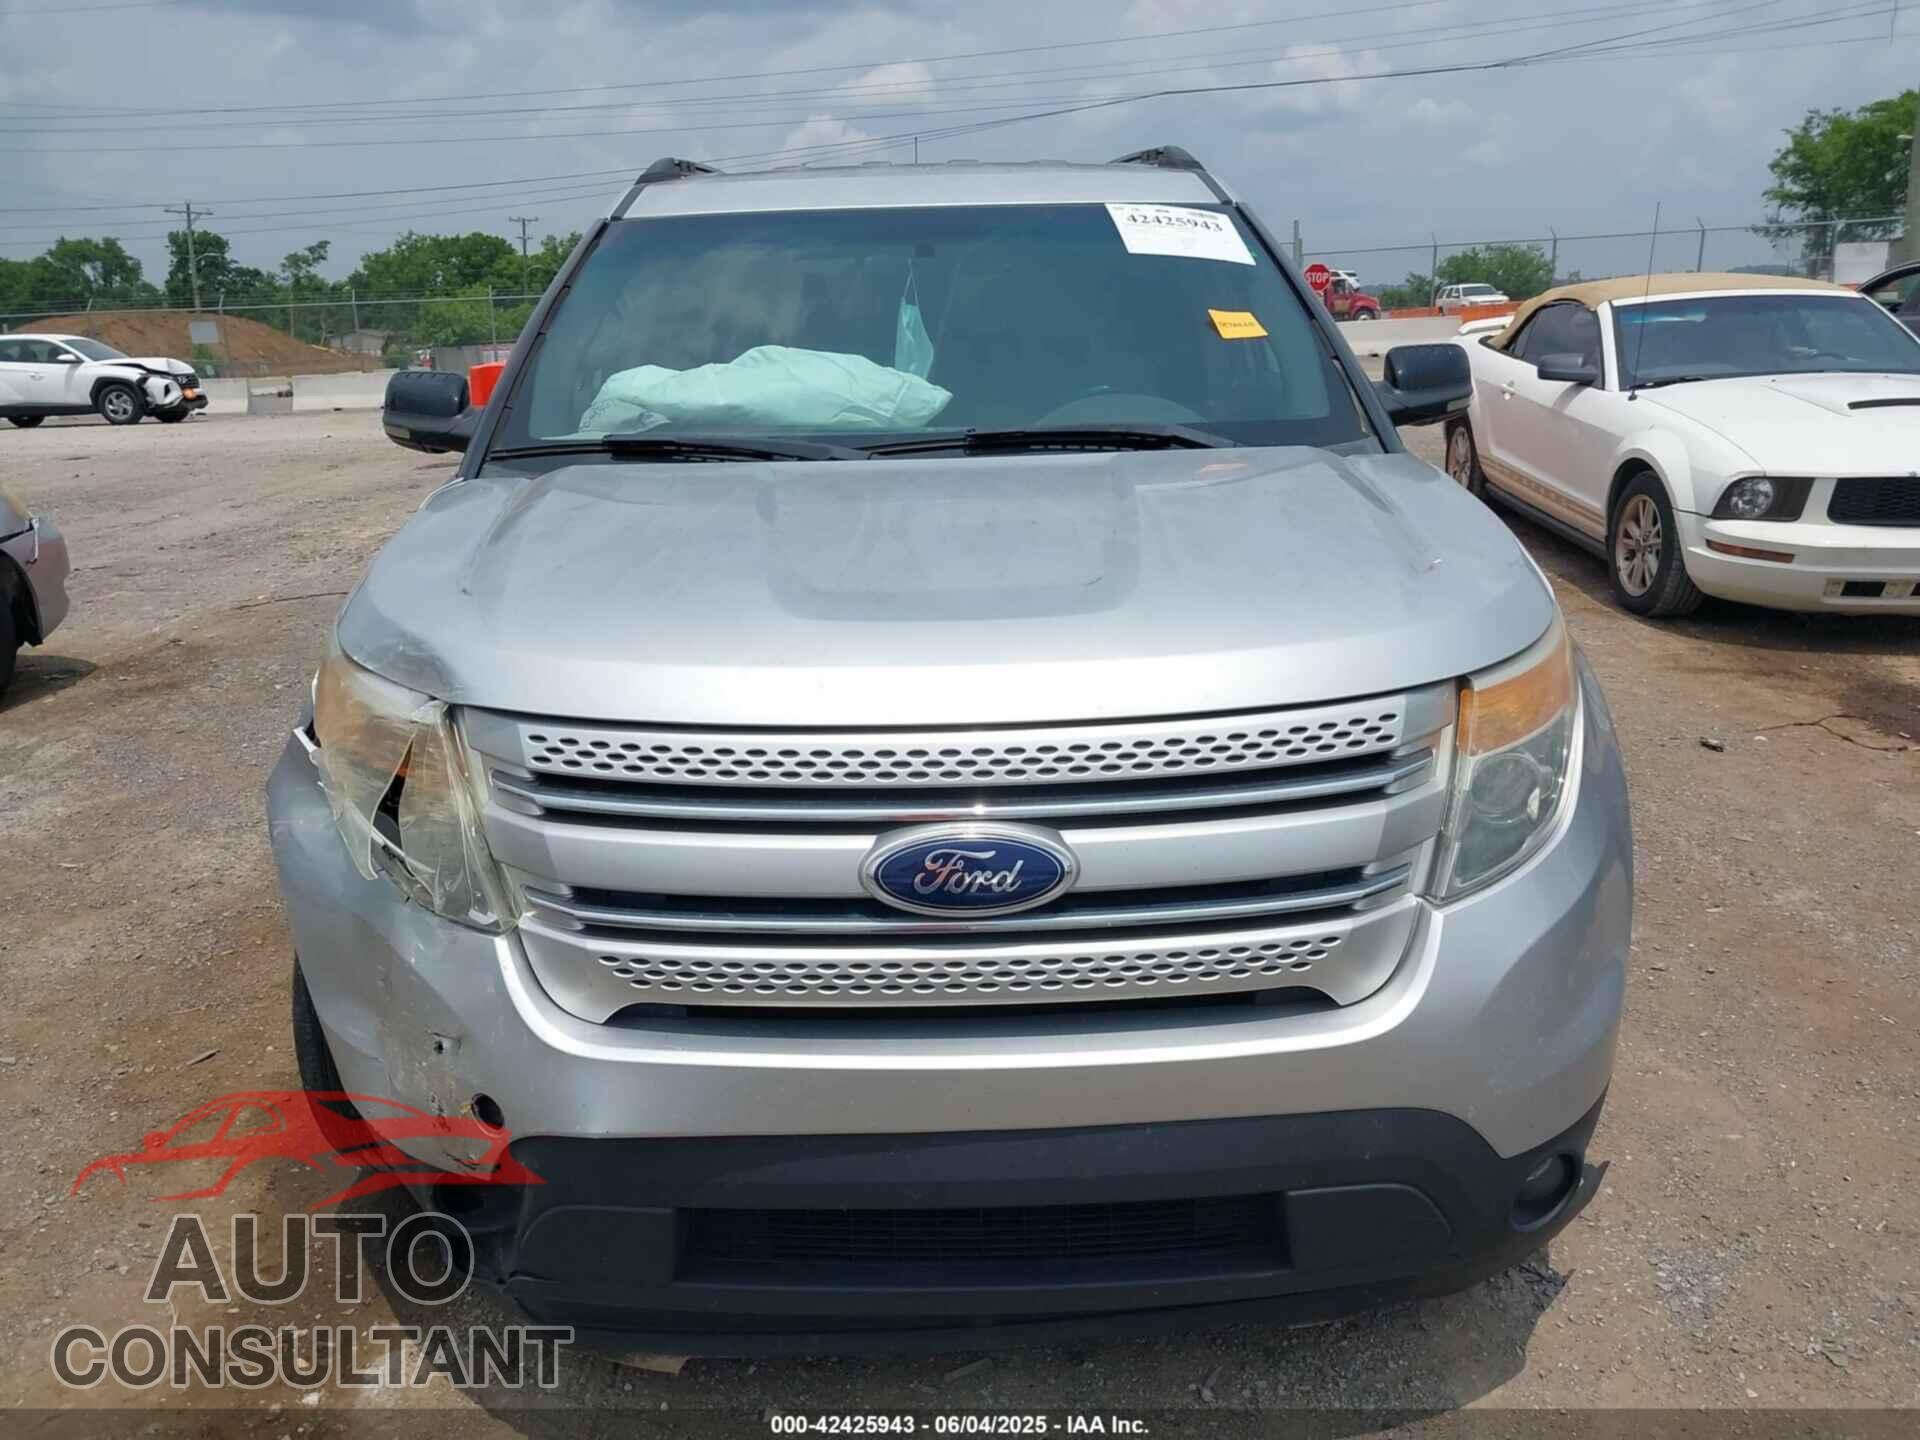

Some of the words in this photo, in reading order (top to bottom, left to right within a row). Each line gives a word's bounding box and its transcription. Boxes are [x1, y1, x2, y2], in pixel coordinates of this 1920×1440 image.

[1127, 213, 1223, 232] 42425943
[1304, 271, 1329, 284] STOP
[913, 849, 1024, 894] Ford
